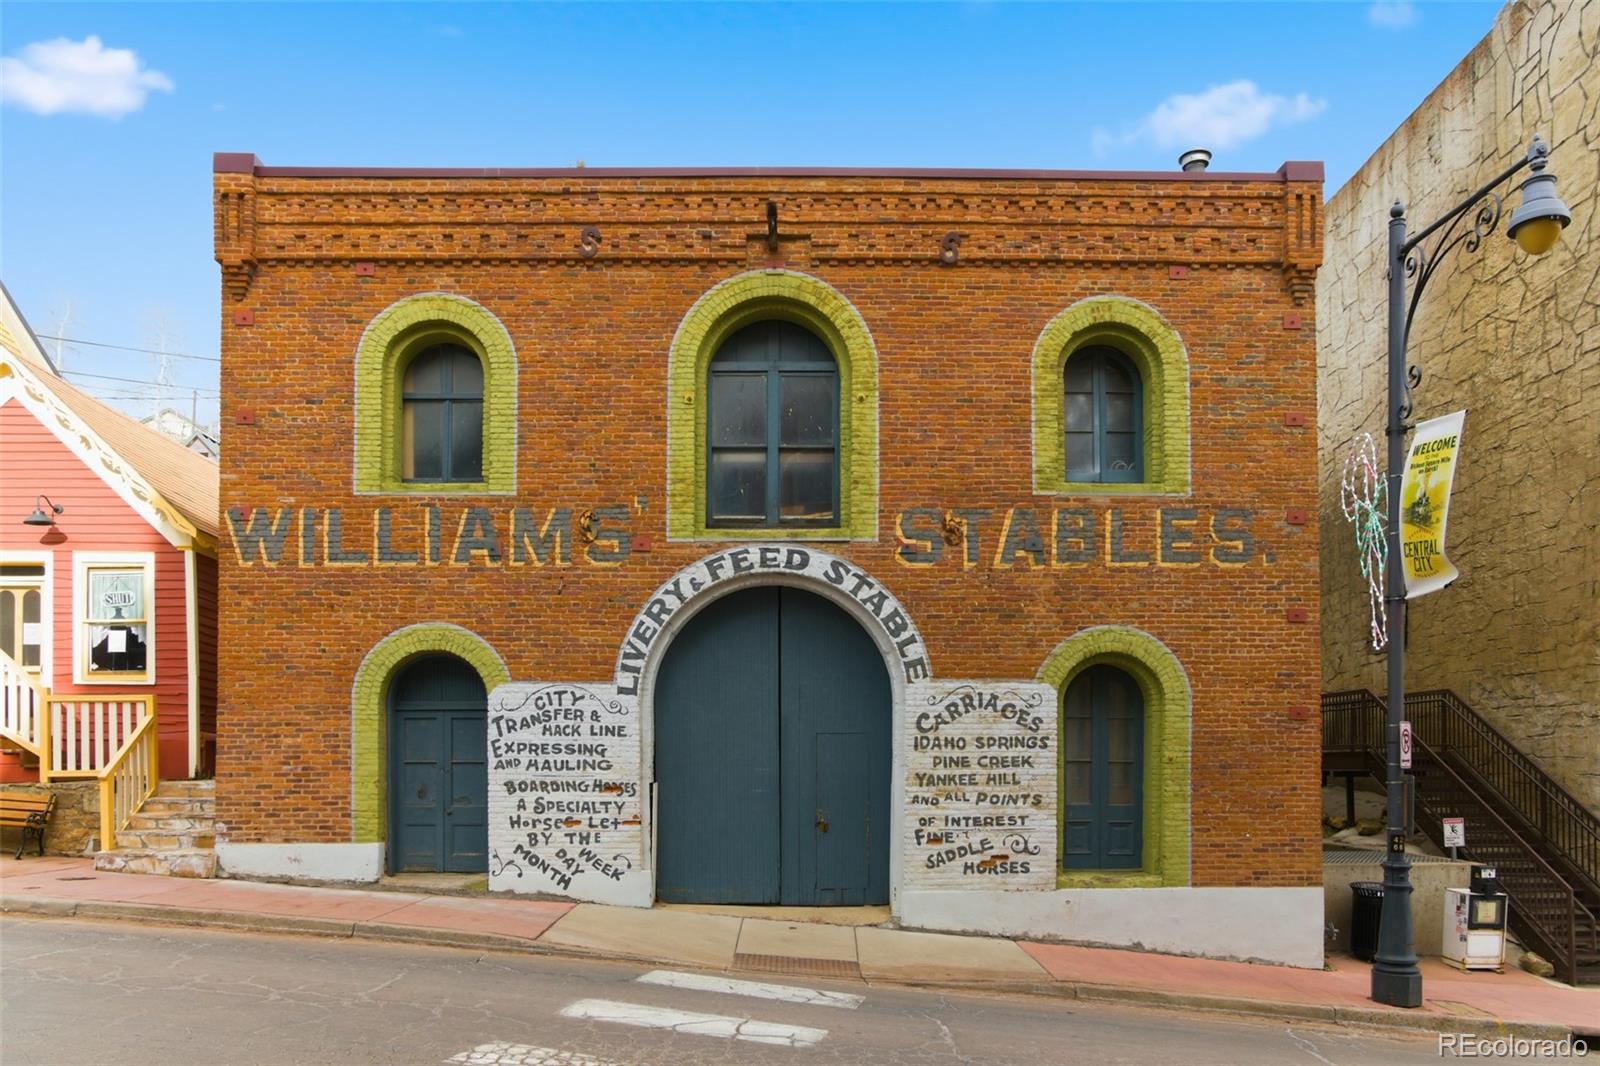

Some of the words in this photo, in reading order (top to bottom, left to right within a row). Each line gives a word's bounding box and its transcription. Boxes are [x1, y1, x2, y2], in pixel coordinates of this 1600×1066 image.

[1412, 436, 1457, 456] WELCOME
[1404, 539, 1440, 558] CENTRAL
[1413, 556, 1433, 572] CITY
[617, 579, 688, 697] LIVERY
[689, 577, 706, 592] &
[704, 547, 811, 582] FEED
[823, 559, 929, 684] STABLE
[534, 690, 586, 711] CITY
[915, 692, 1044, 734] CARRIAGES
[491, 708, 585, 737] TRANSFER
[590, 710, 602, 723] &
[542, 724, 582, 737] HACK
[491, 738, 608, 758] EXPRESSING
[913, 736, 967, 750] IDAHO
[975, 735, 1050, 750] SPRINGS
[494, 758, 521, 770] AND
[525, 759, 613, 772] HAULING
[932, 755, 971, 768] PINE
[977, 755, 1035, 768] CREEK
[504, 779, 590, 795] BOARDING
[915, 772, 978, 787] YANKEE
[985, 772, 1021, 786] HILL
[517, 798, 527, 812] A
[533, 797, 626, 815] SPECIALTY
[911, 795, 940, 806] AND
[944, 792, 970, 802] ALL
[975, 792, 1043, 806] POINTS
[919, 816, 937, 826] OF
[944, 815, 1030, 827] INTEREST
[527, 832, 552, 847] BY
[564, 832, 601, 845] THE
[925, 837, 994, 869] SADDLE
[513, 844, 572, 890] MONTH
[555, 848, 585, 877] DAY
[579, 848, 625, 881] WEEK
[963, 861, 1031, 875] HORSES
